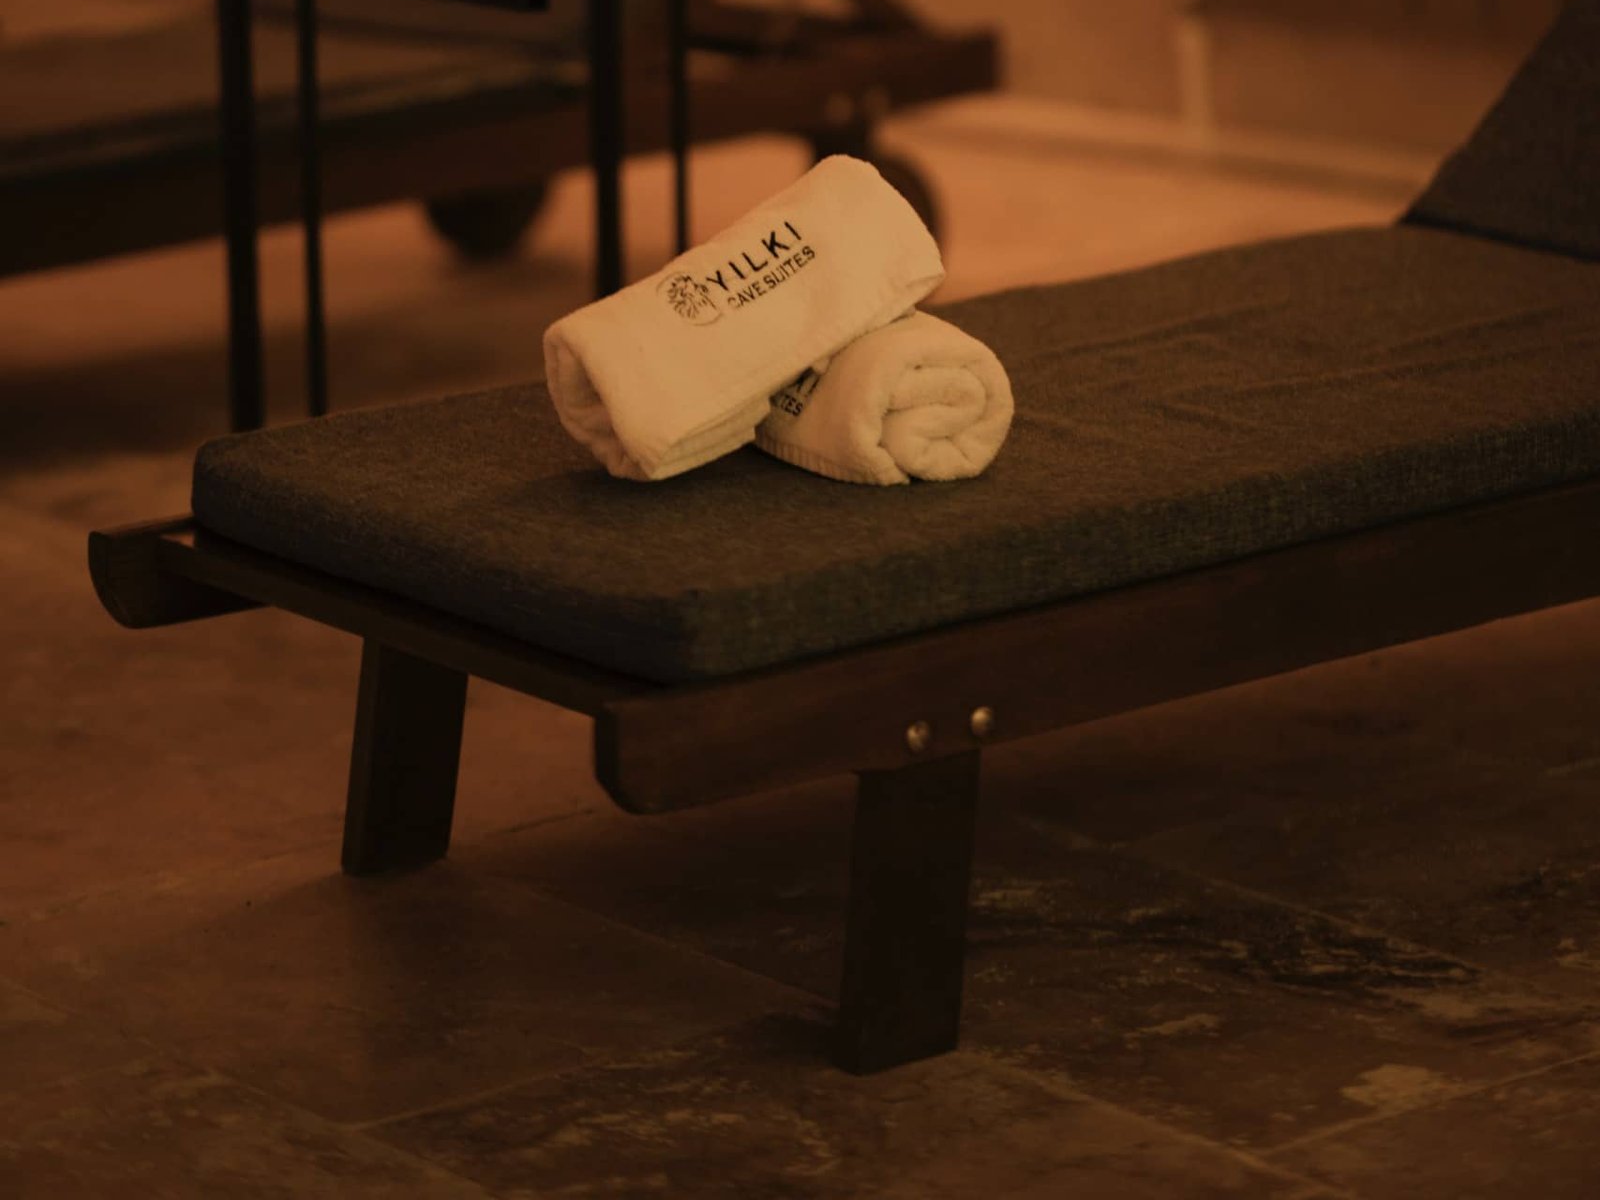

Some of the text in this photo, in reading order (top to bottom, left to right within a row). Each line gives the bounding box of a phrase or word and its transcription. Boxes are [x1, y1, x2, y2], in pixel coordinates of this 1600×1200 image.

[706, 221, 801, 291] YILKI
[727, 245, 815, 310] CAVE SUITES
